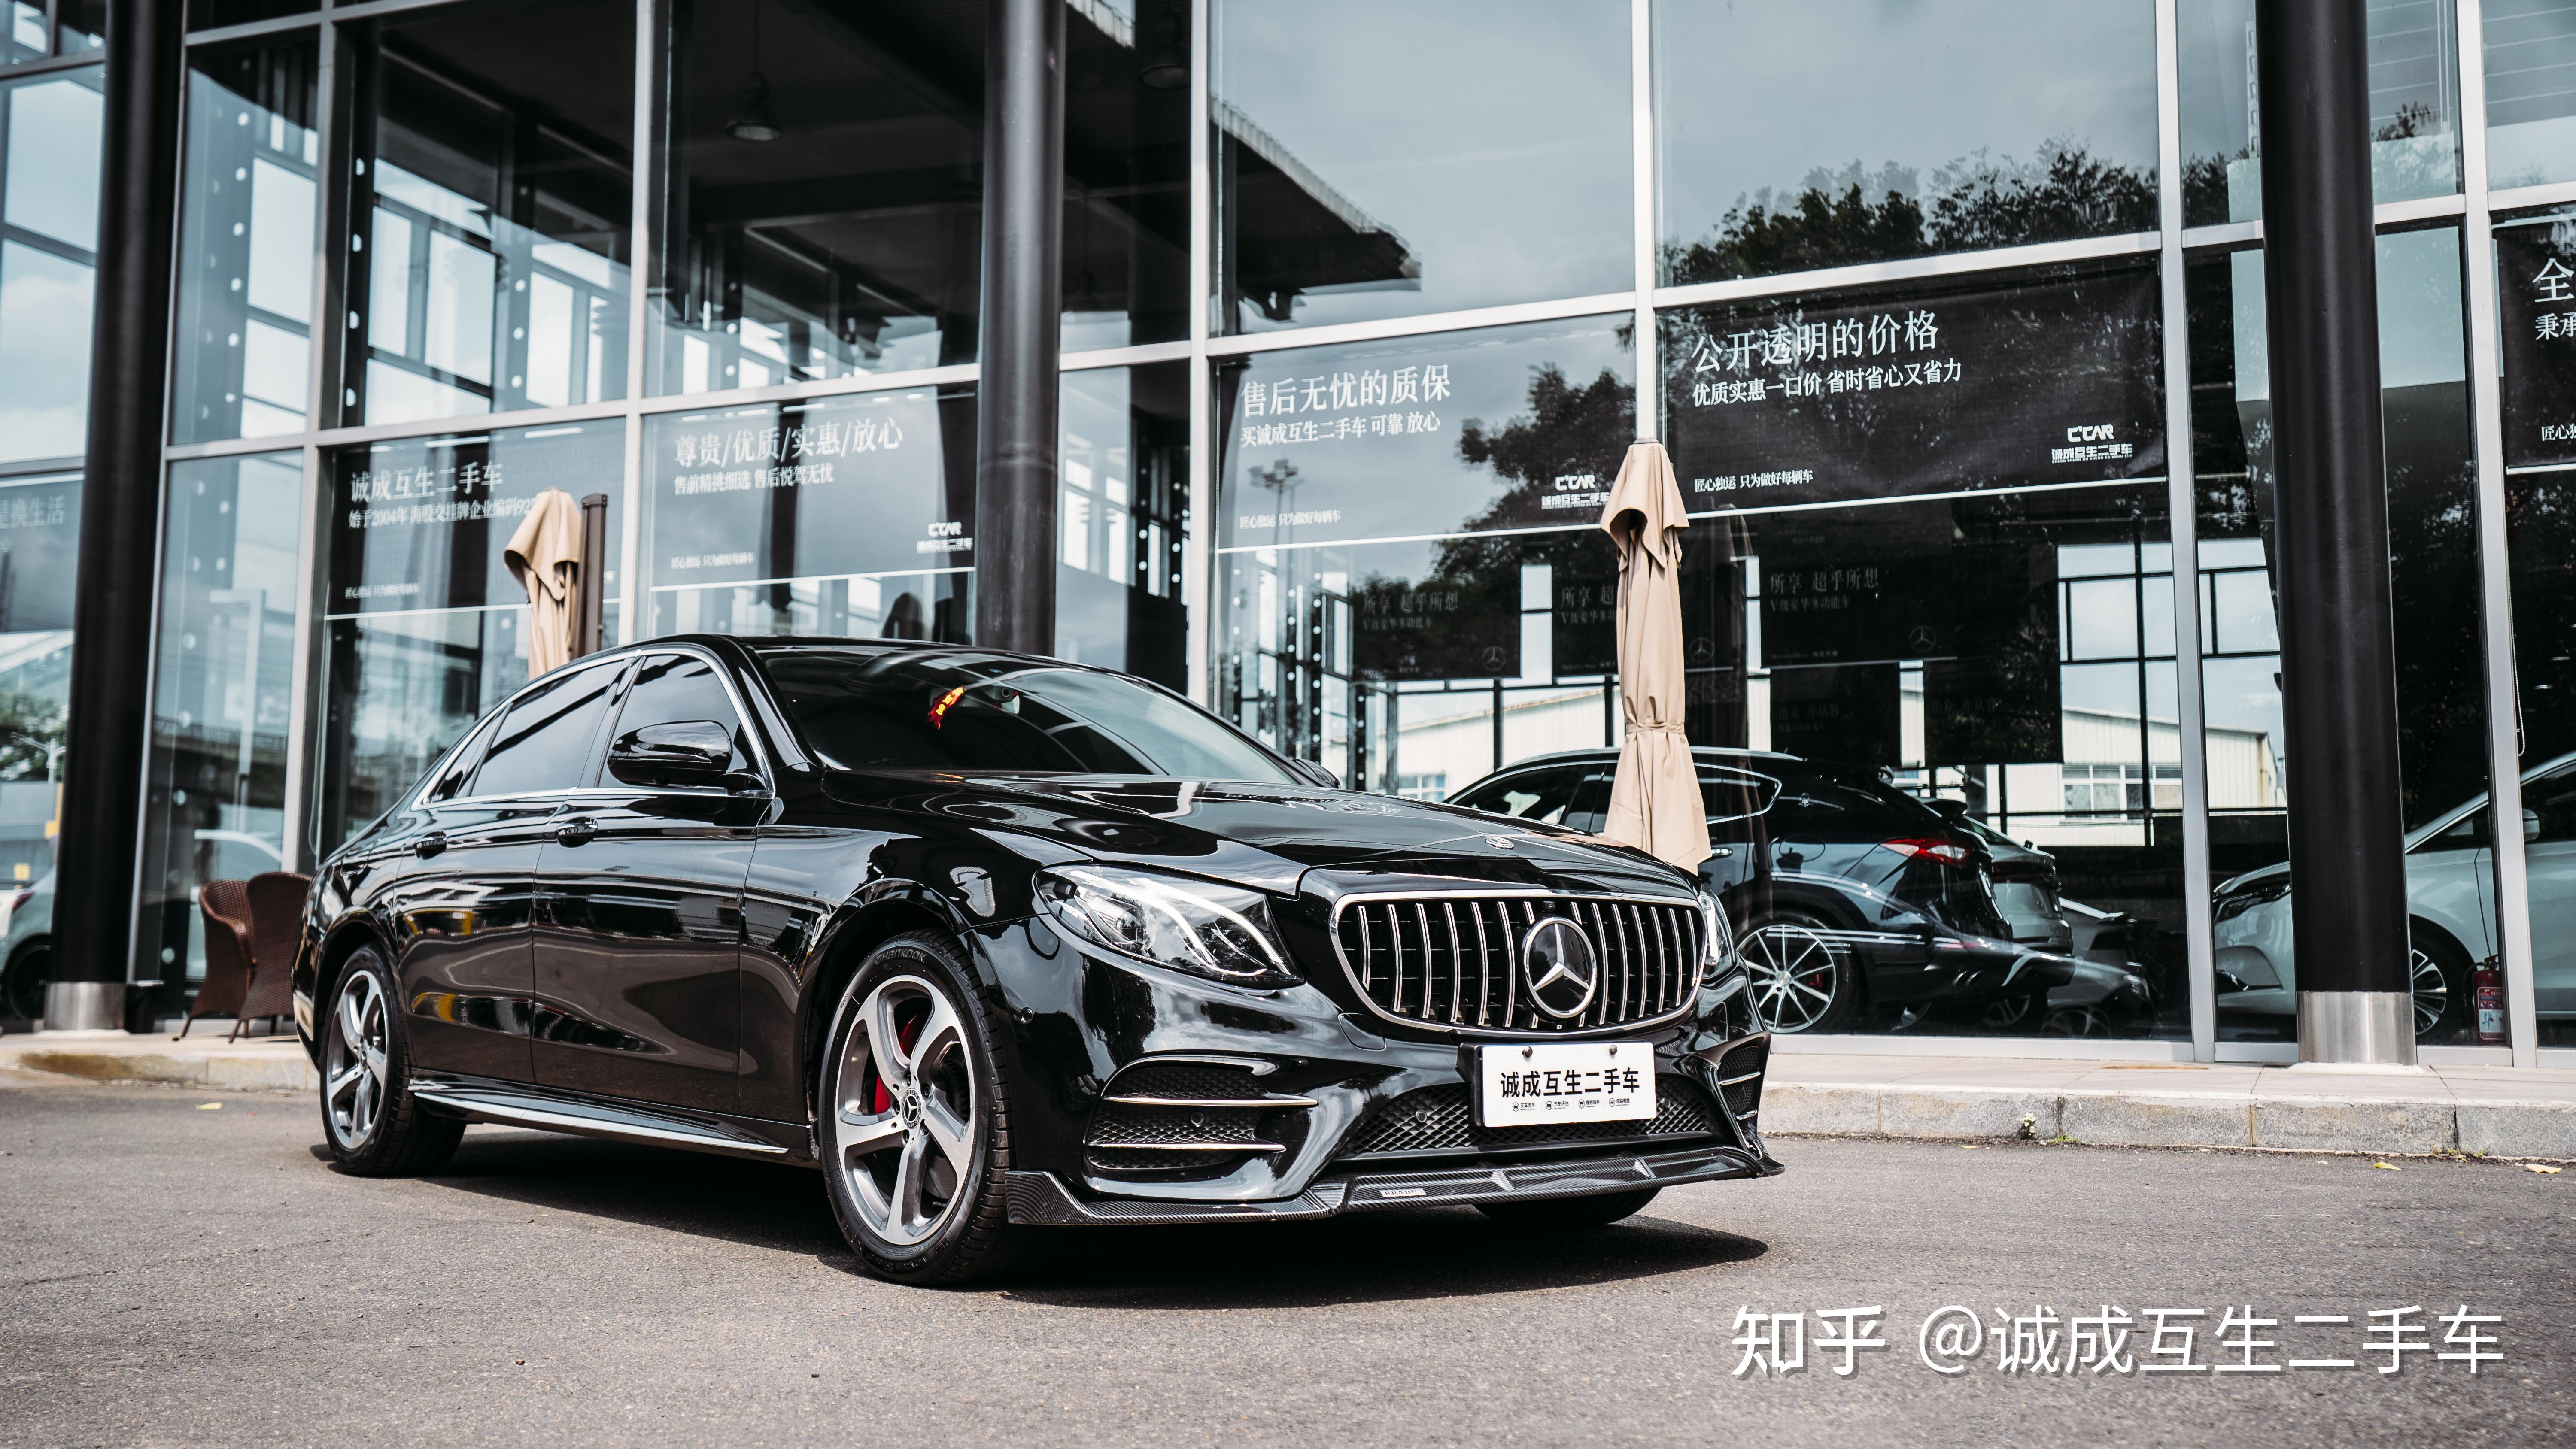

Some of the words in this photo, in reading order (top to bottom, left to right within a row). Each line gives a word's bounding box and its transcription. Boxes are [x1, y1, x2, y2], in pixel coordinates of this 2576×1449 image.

[2533, 258, 2575, 303] 全
[1692, 309, 1938, 373] 公开透明的价格
[1241, 363, 1451, 418] 售后无忧的质保
[1692, 372, 1822, 408] 优质实惠一口价
[1827, 358, 1961, 394] 省时省心又省力
[674, 416, 904, 468] 尊贵/优质/实惠/放心
[1241, 416, 1367, 449] 买诚成互生二手车
[1370, 413, 1403, 437] 可靠
[1406, 410, 1441, 434] 放心
[2051, 443, 2132, 460] 诚成互生二手车
[350, 461, 503, 503] 诚成互生二手车
[1694, 476, 1736, 492] 匠心独运
[1739, 469, 1813, 489] 只为做好每辆车
[1812, 567, 1879, 591] 超乎所想
[1500, 1067, 1640, 1098] 诚成互生二手车
